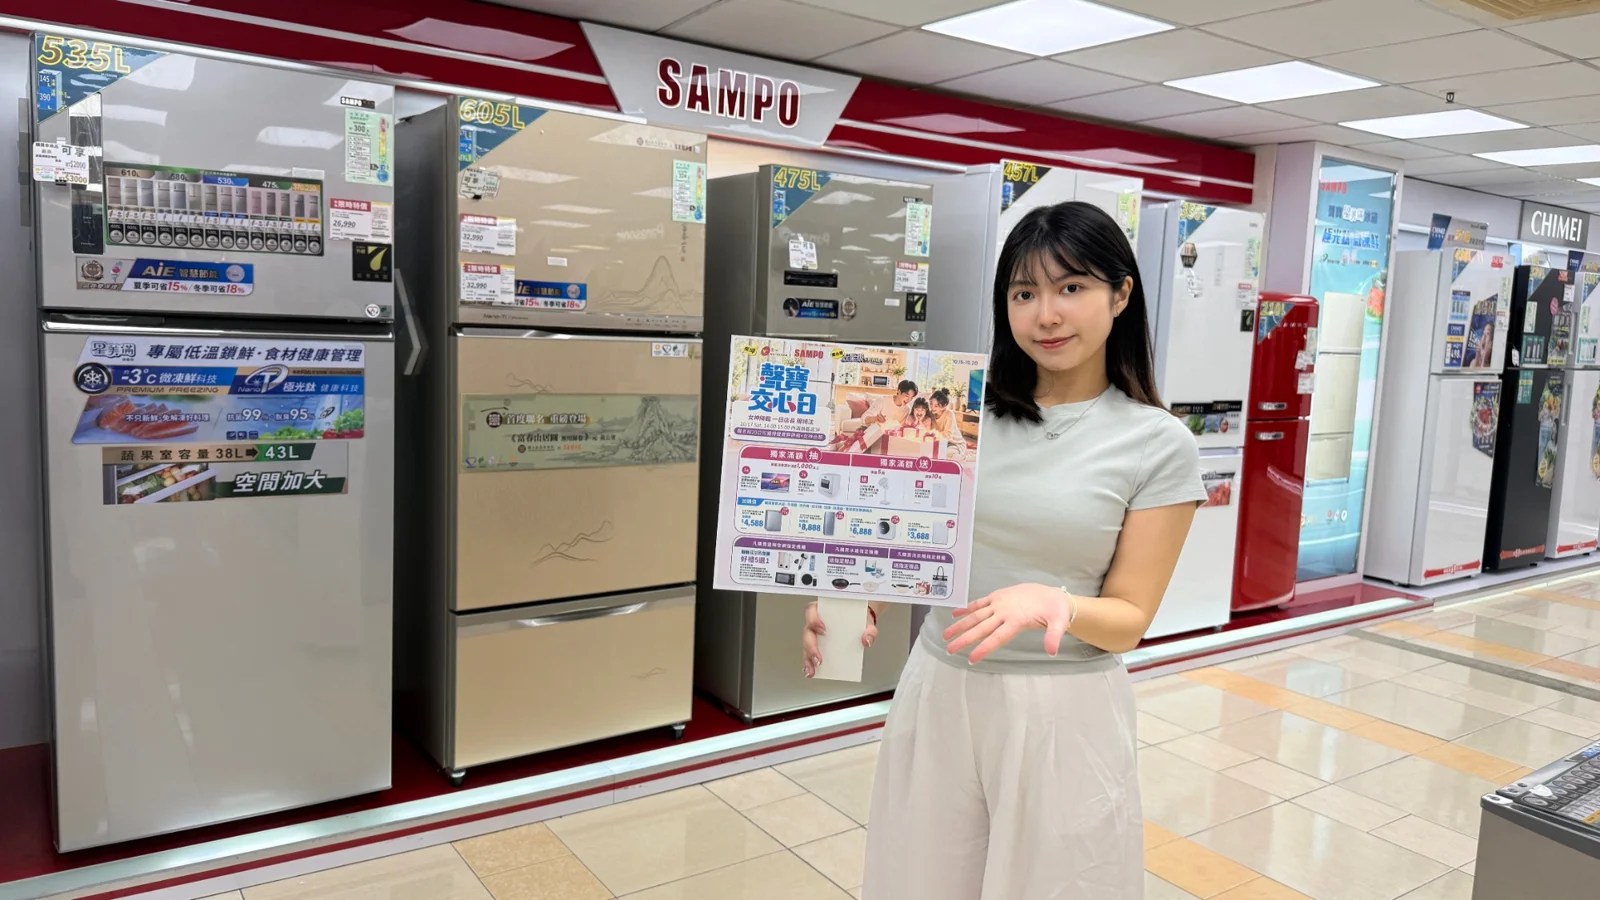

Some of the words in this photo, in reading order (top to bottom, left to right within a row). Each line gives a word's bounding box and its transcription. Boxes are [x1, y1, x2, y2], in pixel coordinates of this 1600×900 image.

[38, 35, 131, 73] 535L
[657, 57, 800, 128] SAMPO
[459, 98, 526, 129] 605L
[774, 167, 821, 191] 475L
[1003, 161, 1039, 183] 457L
[332, 219, 357, 228] 26,990
[1530, 210, 1583, 242] CHIMEI
[794, 348, 824, 359] SAMPO
[160, 372, 217, 384] 微凍鮮科技
[283, 381, 316, 393] 極光鈦
[320, 383, 359, 393] 健康科技
[759, 363, 811, 392] 聲寶
[748, 389, 817, 415] 交心日
[120, 448, 210, 462] 蔬果室容量
[215, 447, 243, 459] 38L
[265, 445, 300, 459] 43L
[808, 451, 819, 460] 抽
[919, 459, 929, 469] 送
[233, 470, 327, 493] 空間加大
